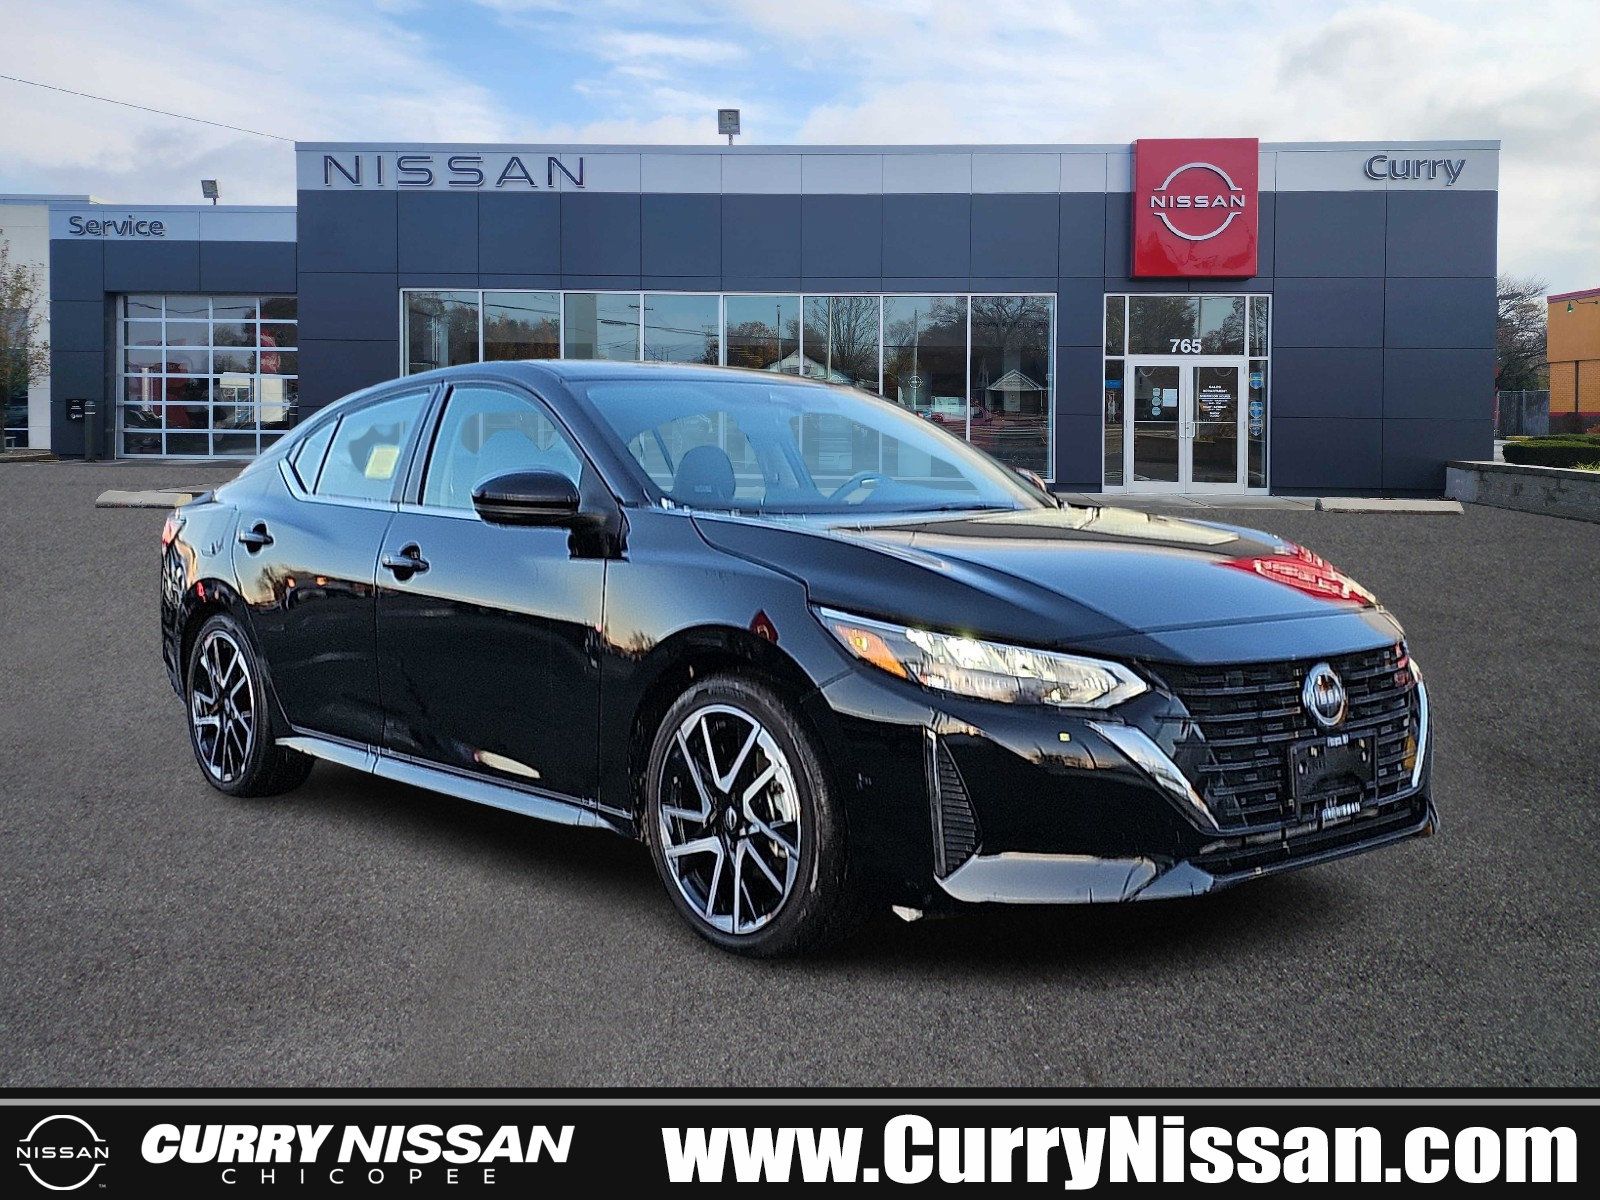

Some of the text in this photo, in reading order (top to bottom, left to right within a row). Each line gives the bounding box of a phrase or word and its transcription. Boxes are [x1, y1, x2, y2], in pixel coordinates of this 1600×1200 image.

[324, 155, 586, 188] NISSAN
[1364, 154, 1466, 186] Curry
[1150, 194, 1246, 209] NISSAN
[68, 214, 166, 236] Service
[1169, 338, 1202, 354] 765
